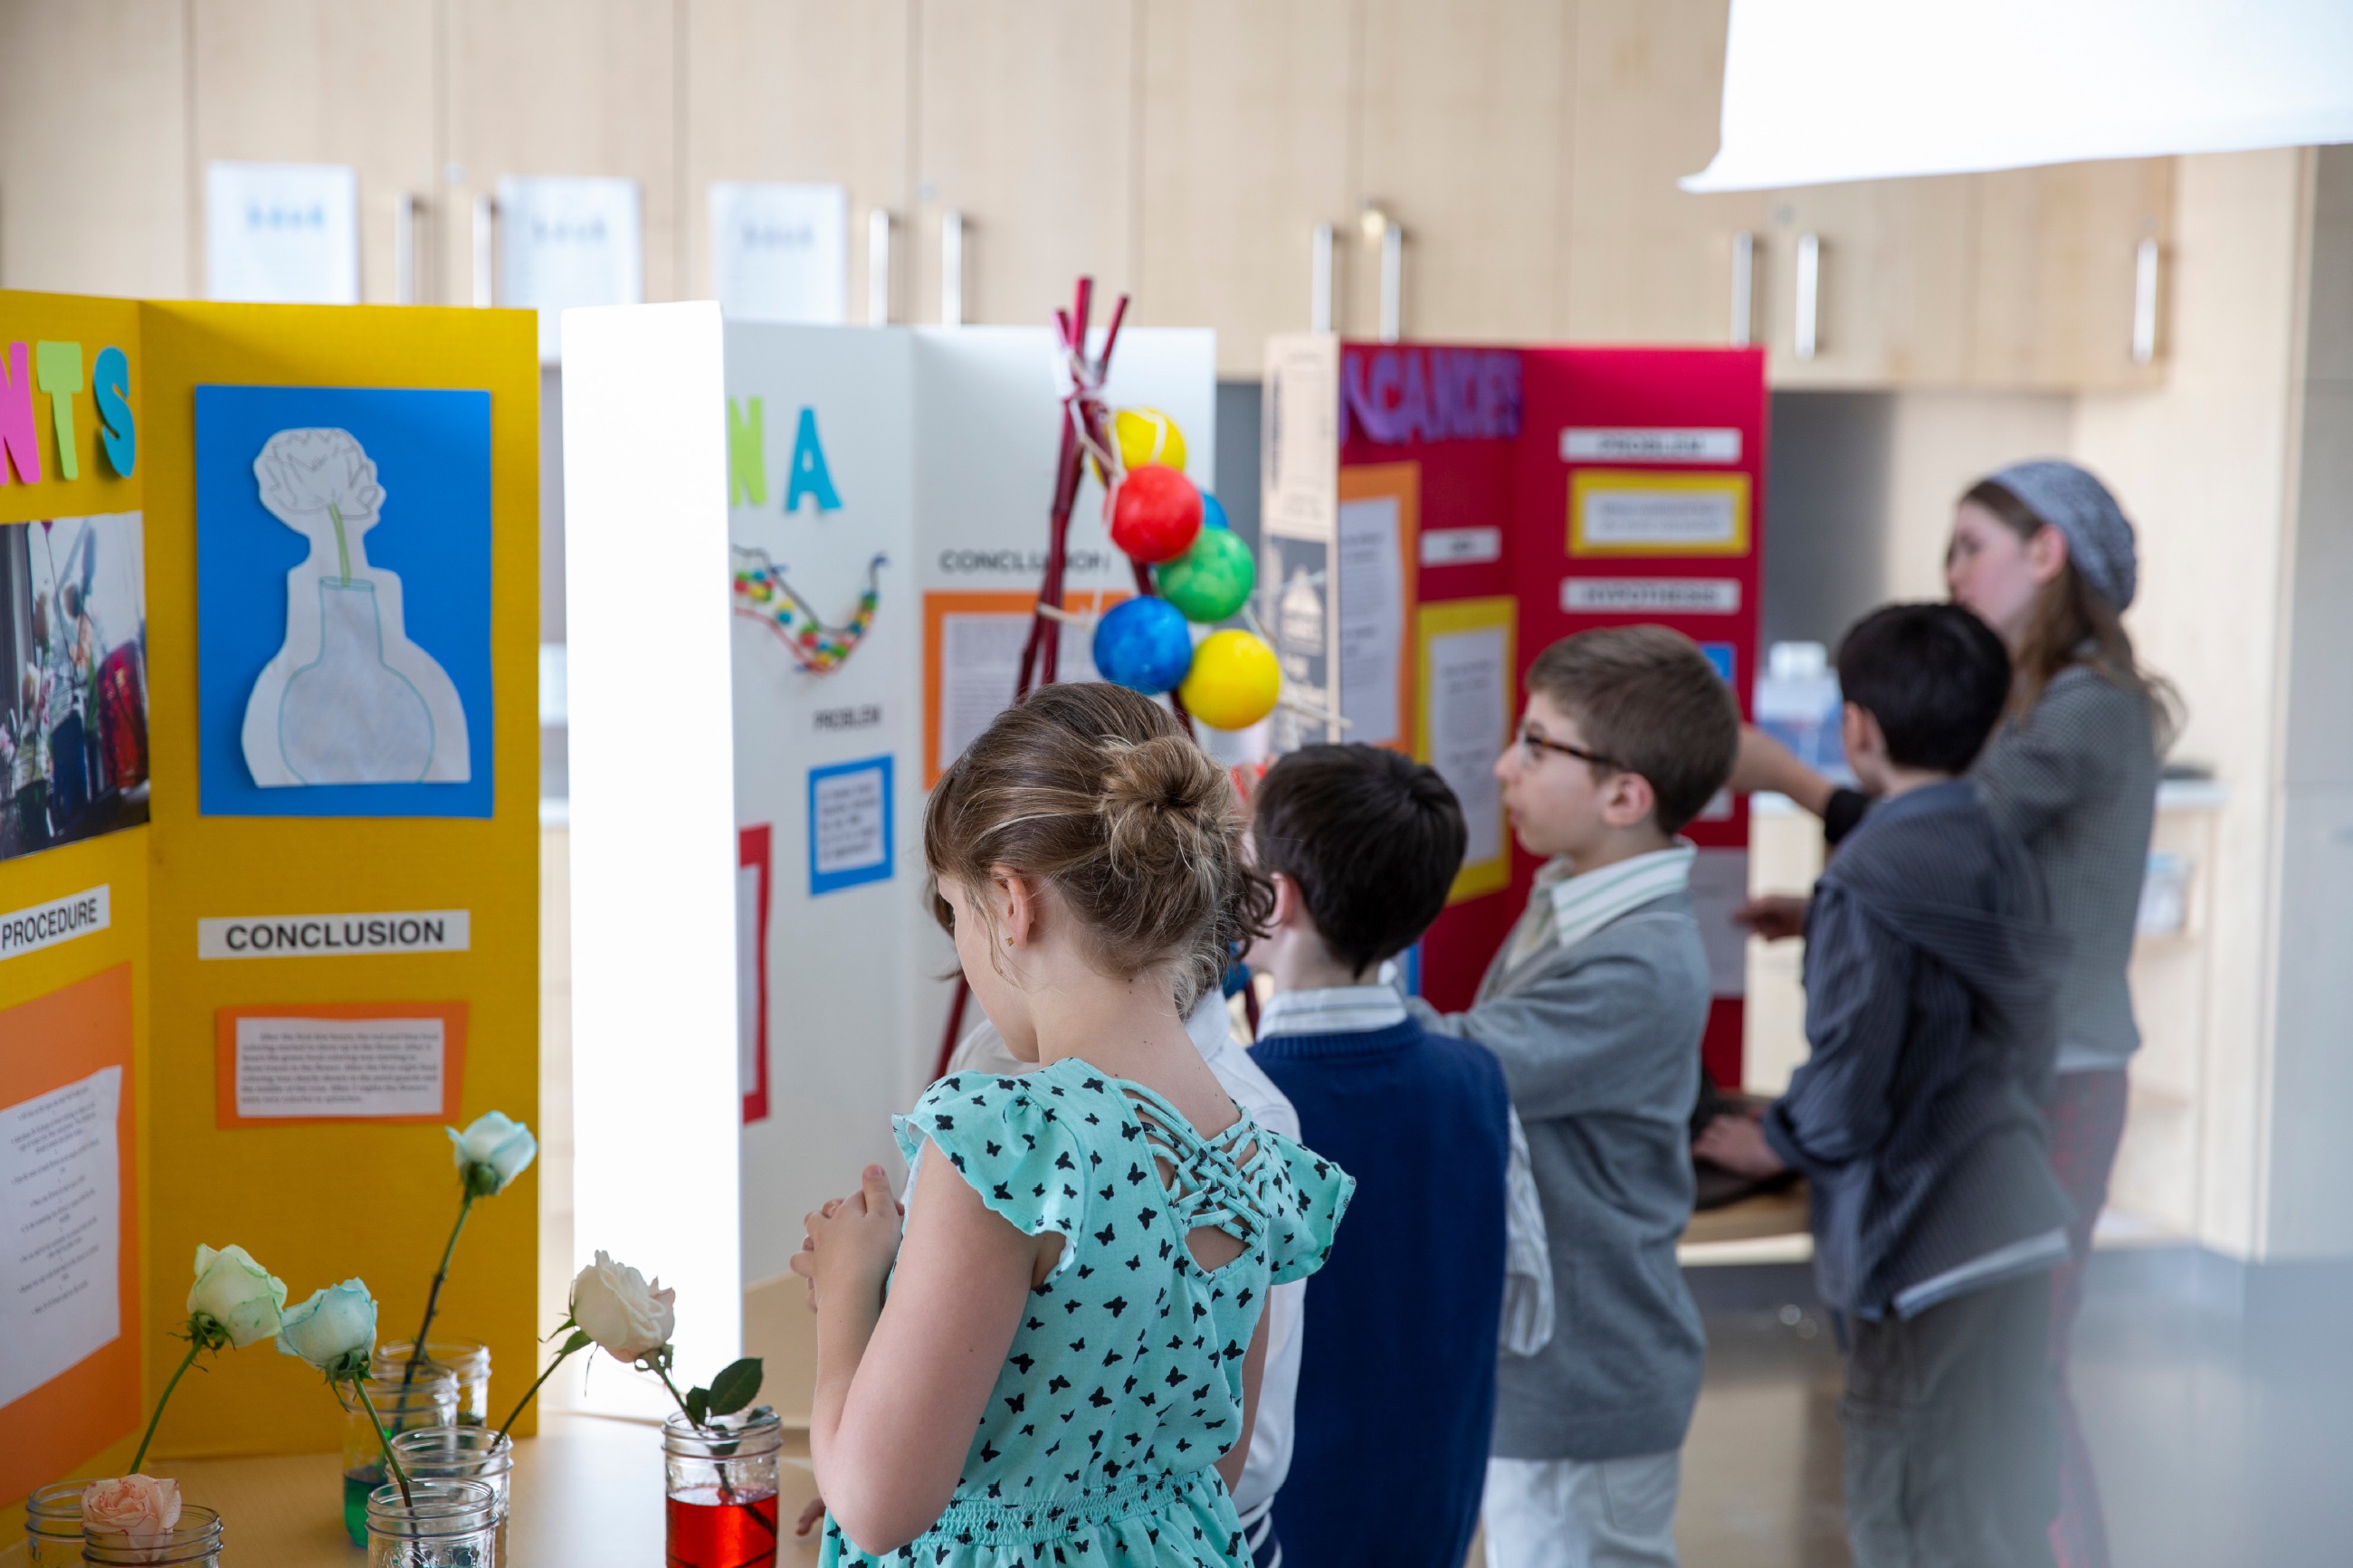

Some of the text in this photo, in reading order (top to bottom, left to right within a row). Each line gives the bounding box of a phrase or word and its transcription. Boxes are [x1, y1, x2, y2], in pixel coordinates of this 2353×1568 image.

[938, 548, 1111, 575] CONCLUON
[1, 897, 98, 951] PROCEDURE
[225, 918, 446, 951] CONCLUSION
